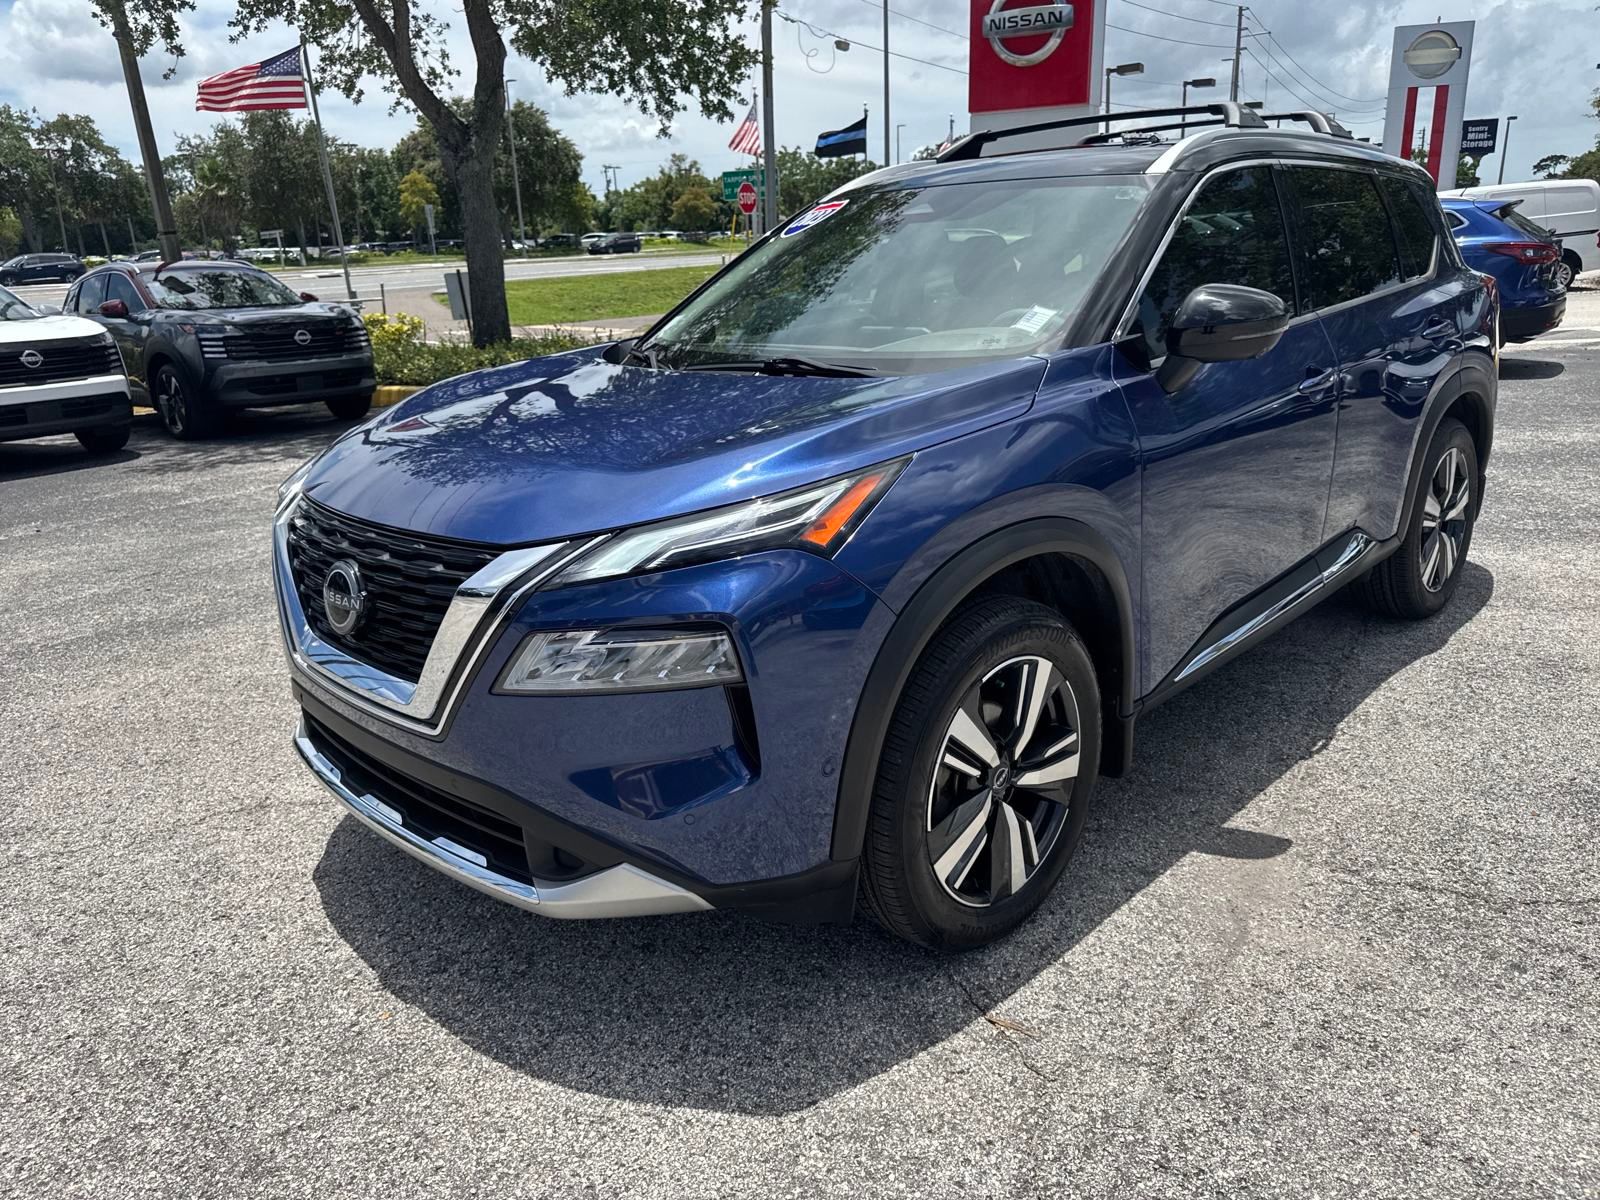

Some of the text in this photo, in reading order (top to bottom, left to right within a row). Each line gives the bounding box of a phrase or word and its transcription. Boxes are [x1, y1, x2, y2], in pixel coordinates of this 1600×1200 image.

[989, 11, 1063, 31] NISSAN
[1462, 140, 1494, 149] Storage
[739, 192, 755, 205] STOP
